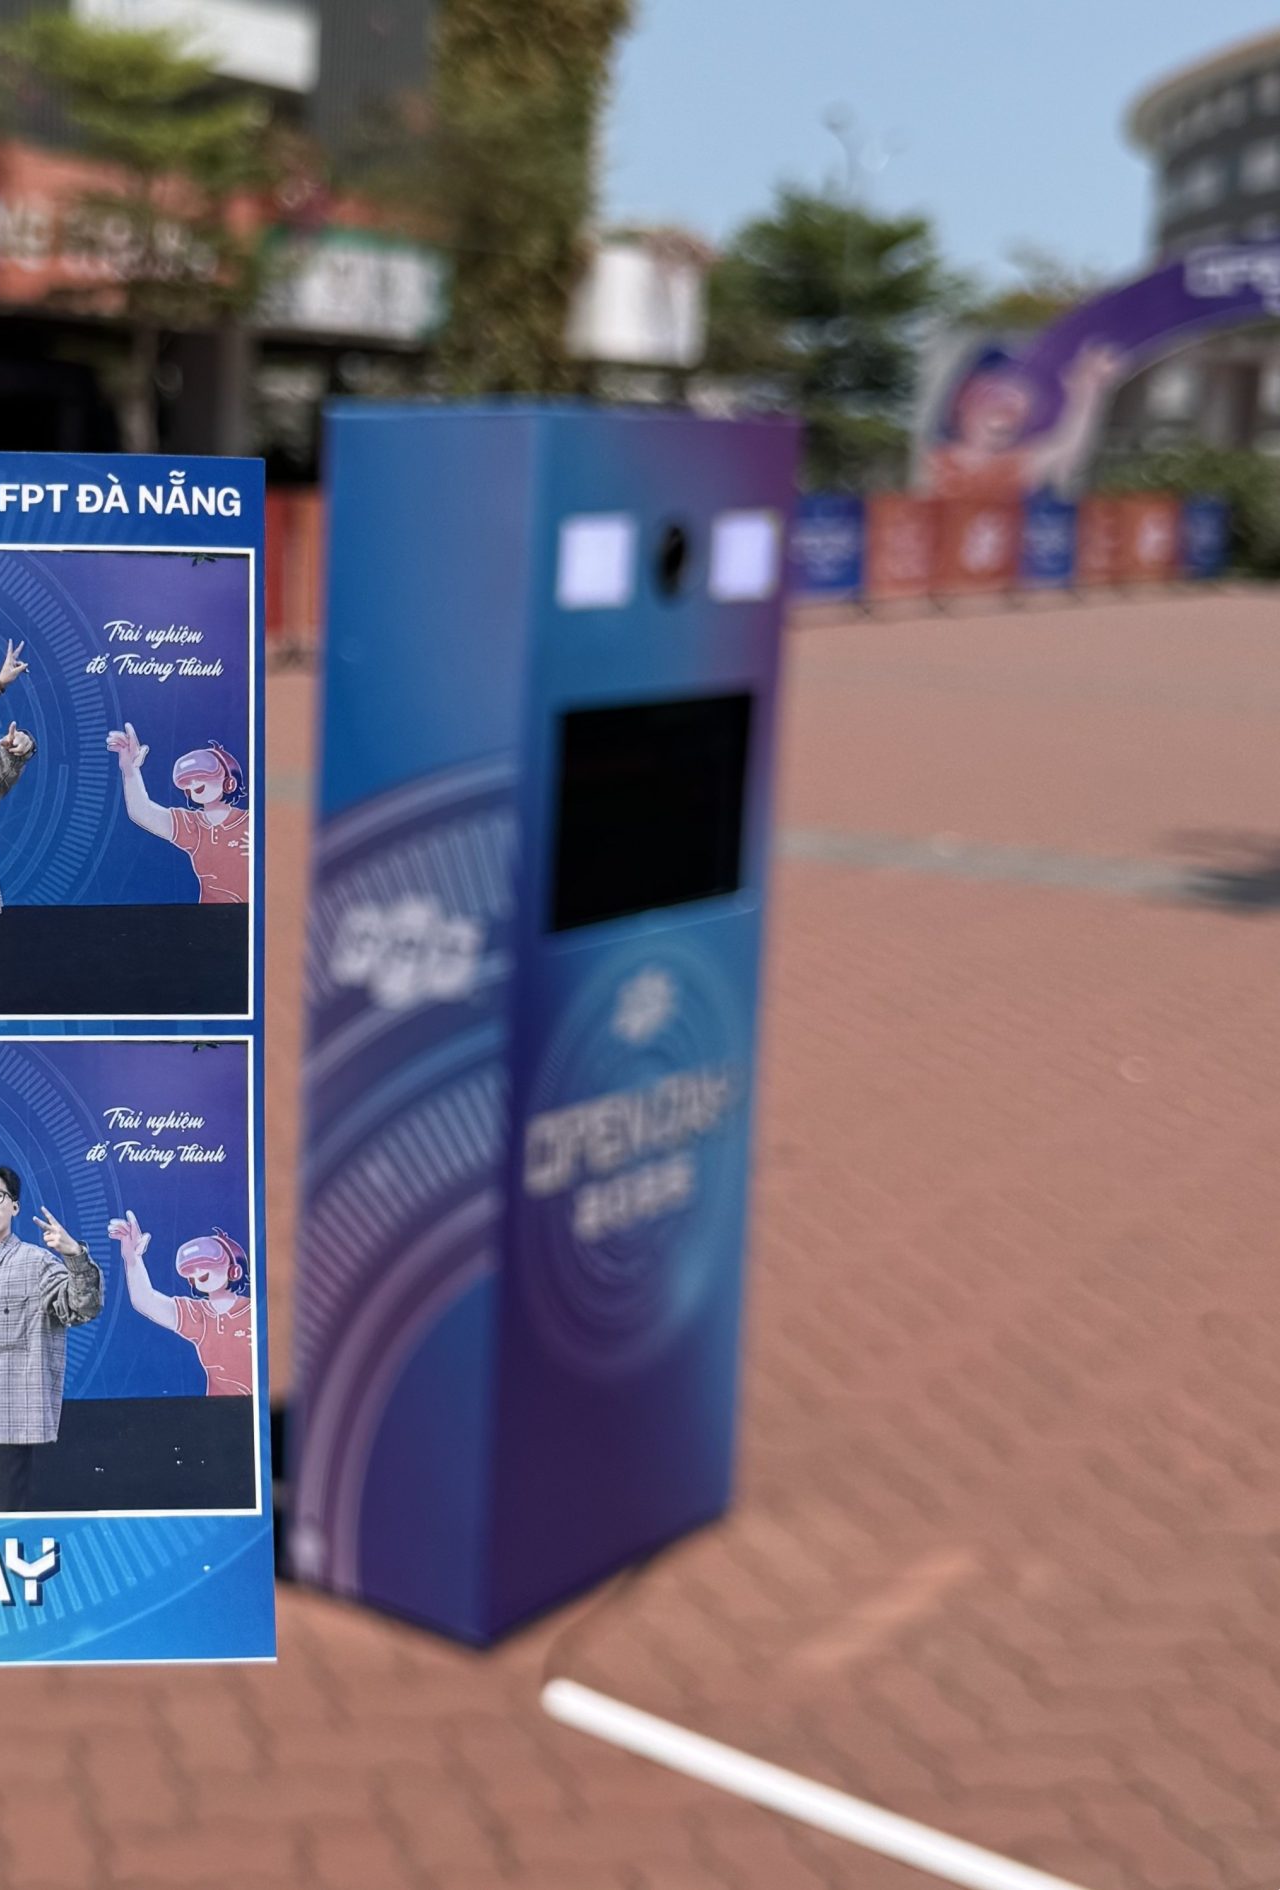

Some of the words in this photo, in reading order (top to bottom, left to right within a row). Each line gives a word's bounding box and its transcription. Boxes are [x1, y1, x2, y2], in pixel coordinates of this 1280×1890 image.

[76, 473, 130, 514] ĐÀ
[138, 470, 242, 518] NẴNG
[103, 620, 143, 642] Trải
[145, 624, 204, 649] nghiệm
[86, 653, 111, 674] để
[113, 653, 176, 682] Trưởng
[103, 1107, 143, 1129] Trải
[146, 1110, 206, 1136] nghiệm
[86, 1140, 111, 1162] để
[113, 1141, 177, 1169] Trưởng
